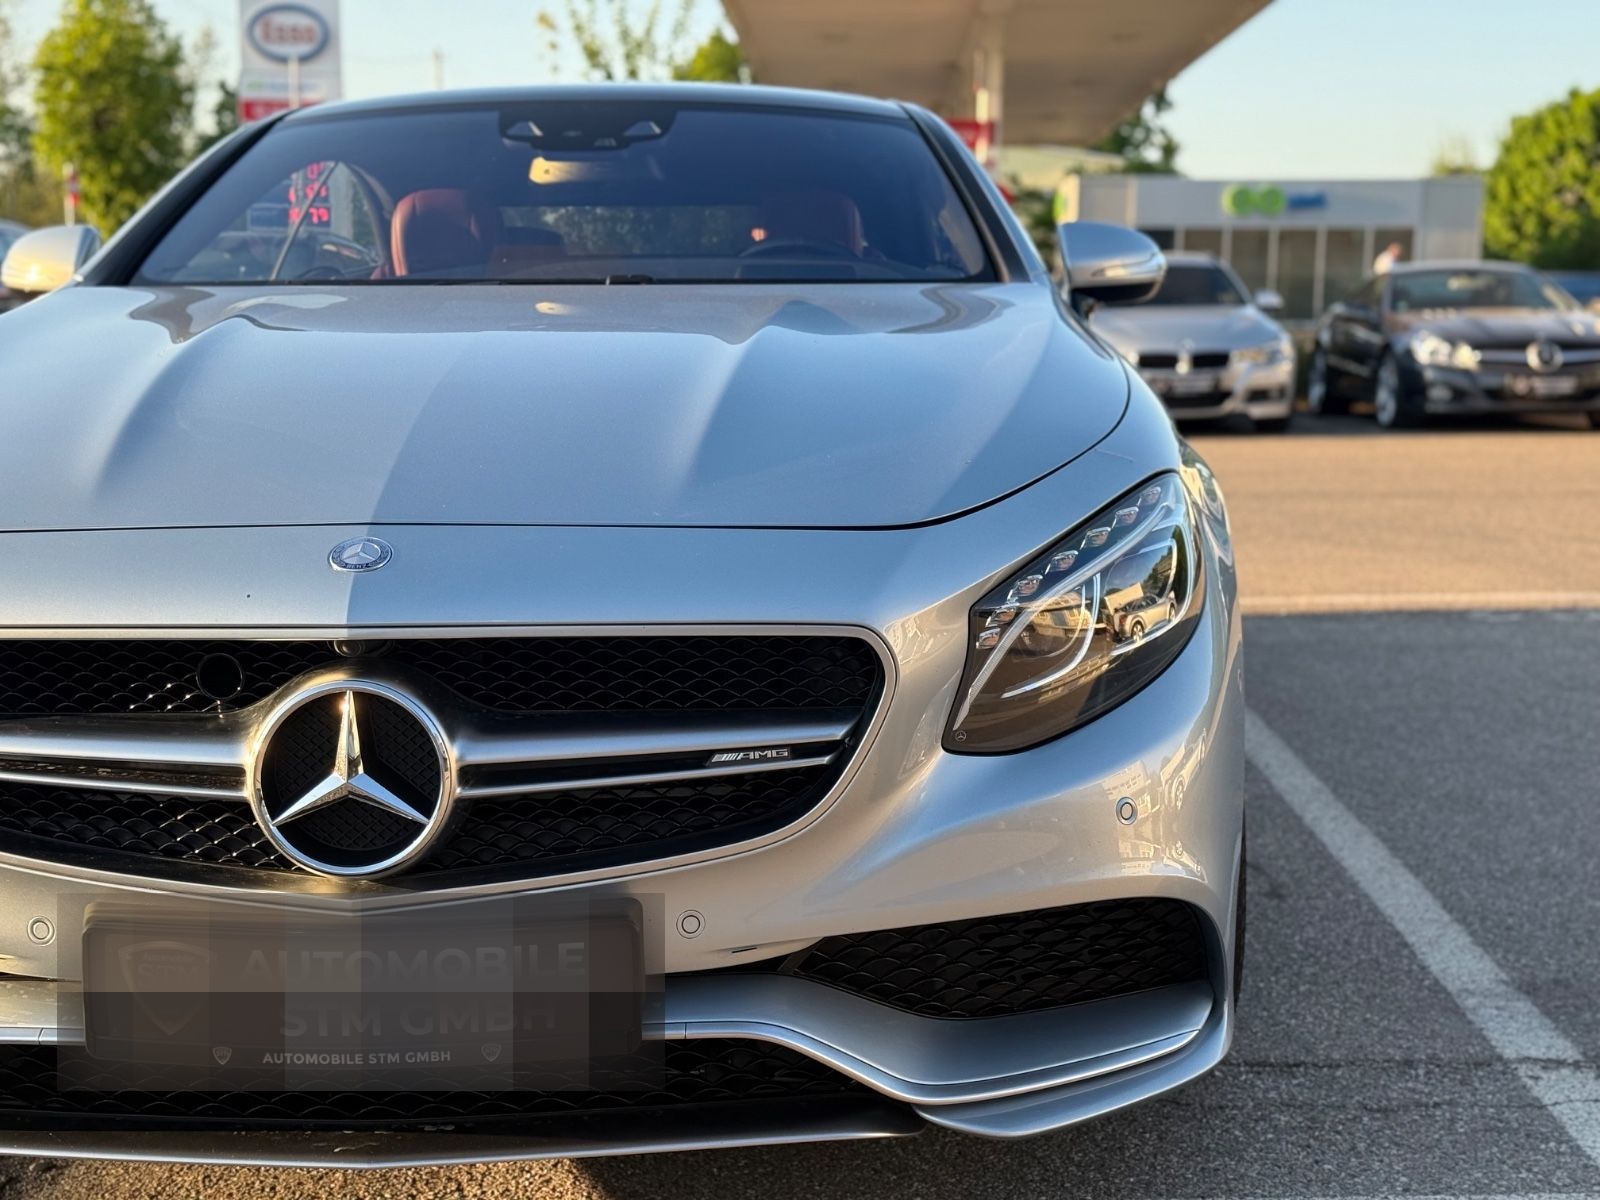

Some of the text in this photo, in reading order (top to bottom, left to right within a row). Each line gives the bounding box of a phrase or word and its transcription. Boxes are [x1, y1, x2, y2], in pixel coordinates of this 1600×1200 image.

[137, 964, 200, 988] STM
[240, 942, 587, 984] AUTOMOBILE
[278, 997, 557, 1037] STM GMBH
[262, 1050, 451, 1065] AUTOMOBILE STM GMBH
